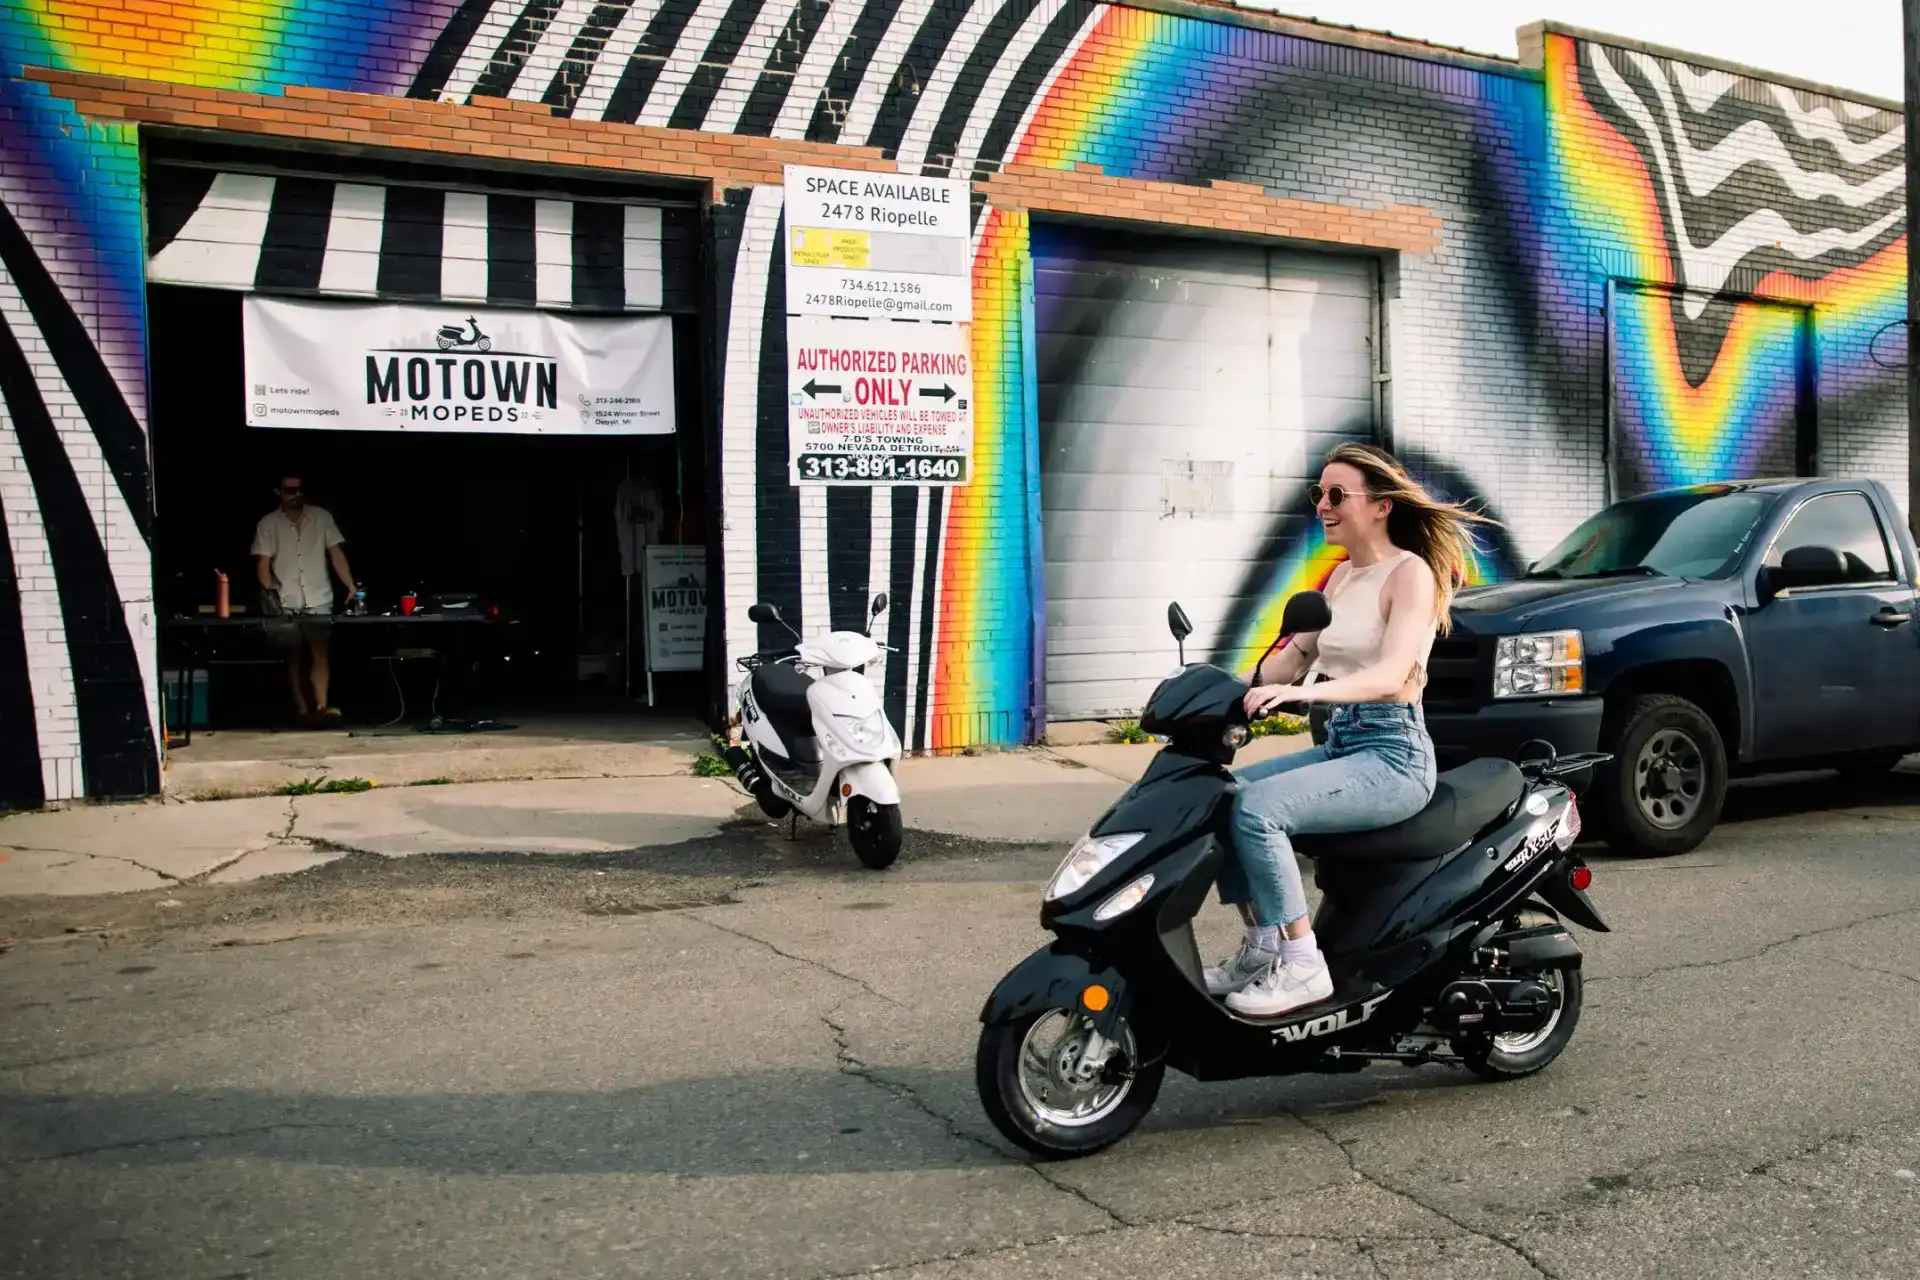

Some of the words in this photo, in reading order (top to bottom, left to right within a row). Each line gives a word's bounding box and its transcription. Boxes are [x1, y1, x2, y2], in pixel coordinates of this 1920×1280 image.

[806, 177, 859, 196] SPACE
[863, 183, 950, 203] AVAILABLE
[822, 203, 864, 220] 2478
[871, 207, 938, 226] Riopelle
[841, 279, 921, 294] 734.612.1586
[805, 293, 952, 312] 2478Riopelle@gmail.com
[797, 348, 897, 373] AUTHORIZED
[902, 352, 967, 376] PARKING
[366, 355, 558, 410] MOTOWN
[855, 377, 912, 406] ONLY
[271, 407, 340, 416] motownmopeds
[412, 405, 519, 422] MOPEDS
[798, 407, 859, 420] UNAUTHORIZED
[860, 409, 898, 421] VEHICLES
[900, 410, 917, 421] WILL
[919, 410, 929, 422] BE
[931, 411, 957, 422] TOWED
[821, 422, 856, 434] OWNER'S
[858, 422, 895, 434] LIABILITY
[896, 424, 911, 435] AND
[914, 424, 946, 436] EXPENSE
[805, 443, 834, 451] 5700
[838, 443, 886, 452] NEVADA
[843, 435, 872, 443] 7-D'S
[877, 436, 924, 444] TOWING
[805, 457, 960, 478] 313-891-1640
[1271, 989, 1394, 1042] WOLF
